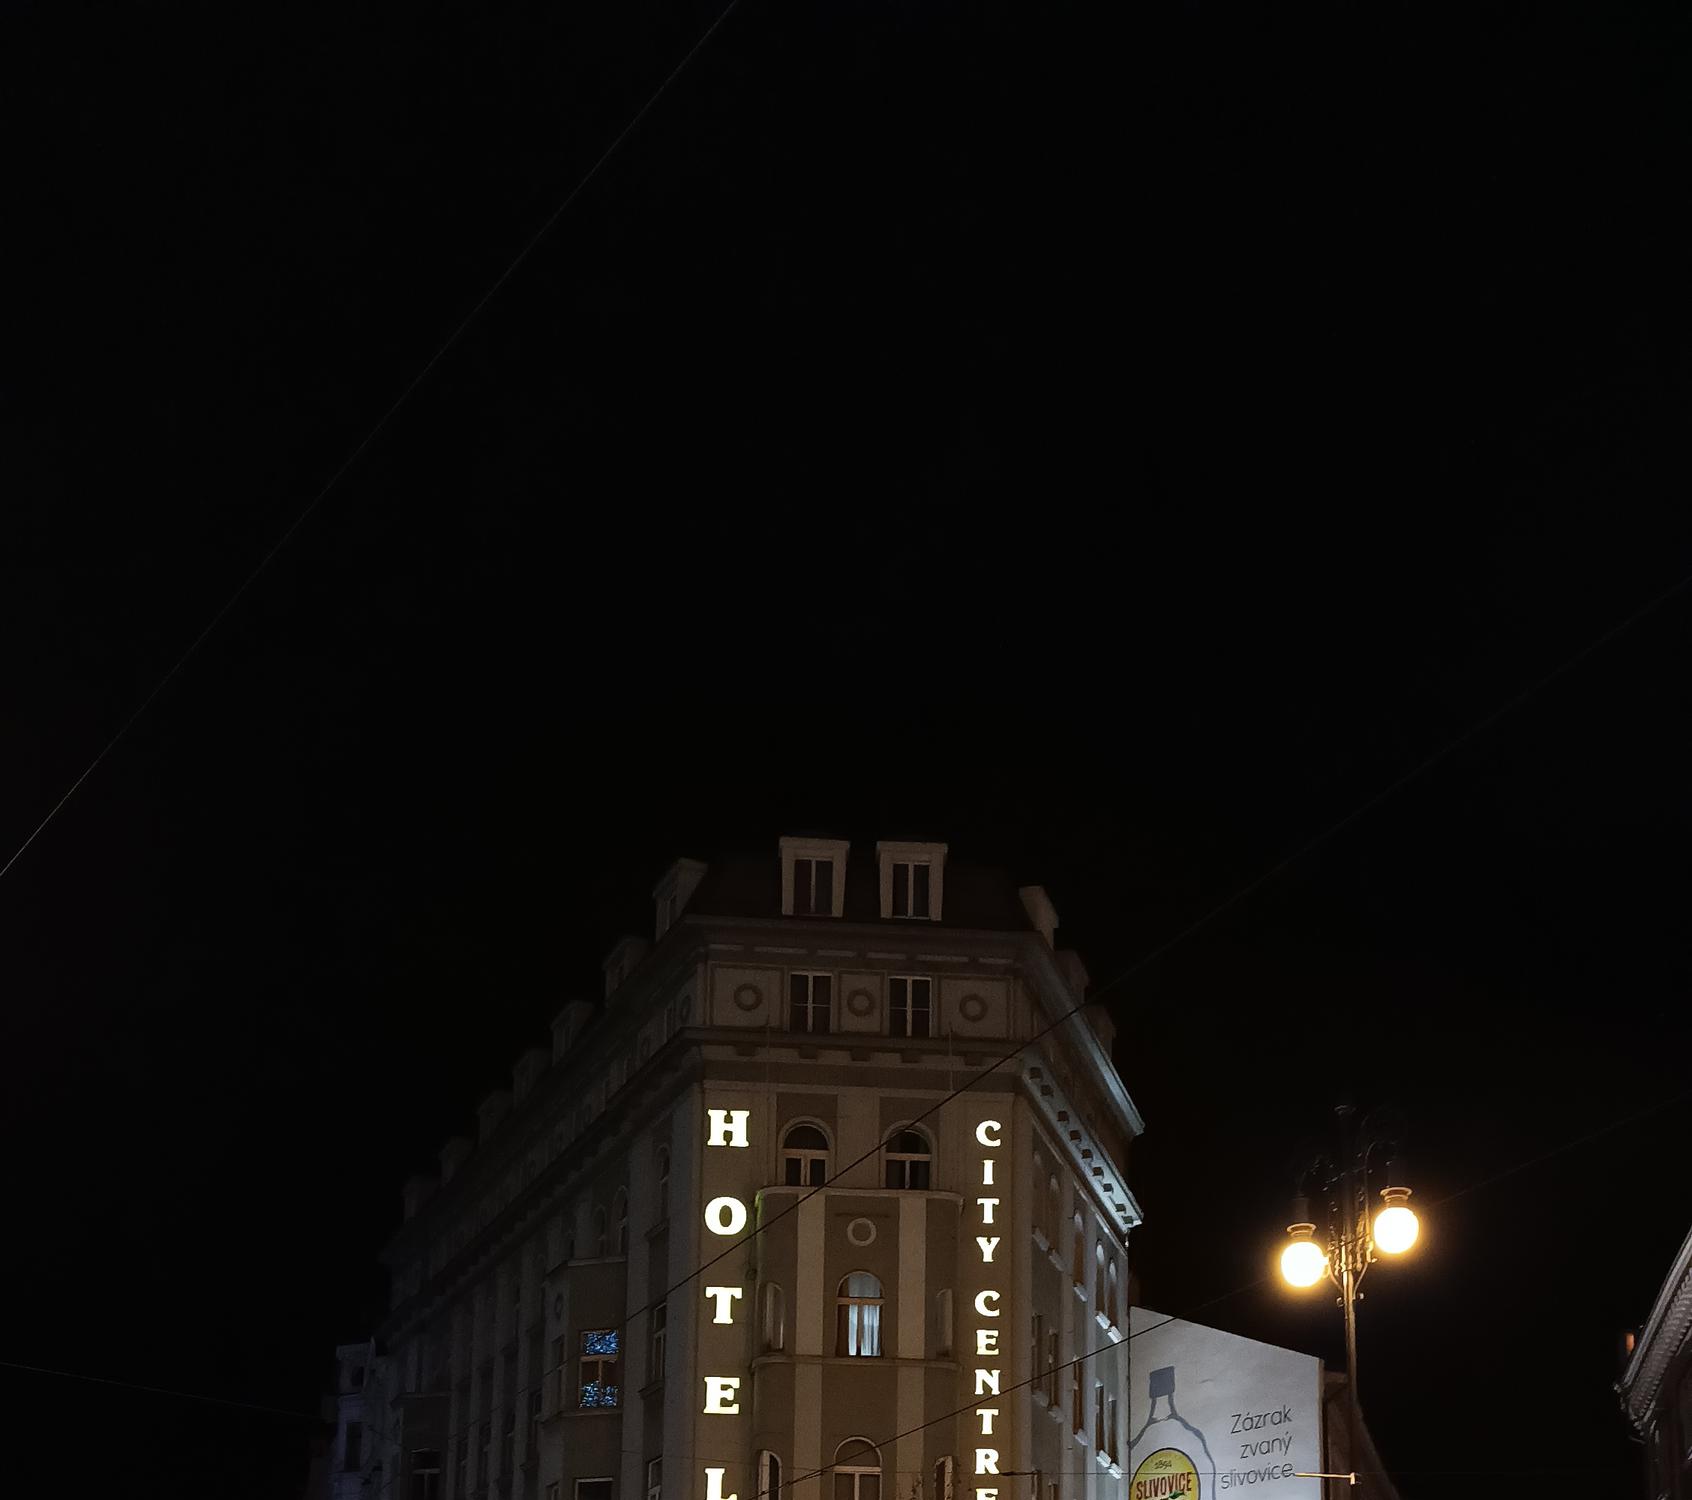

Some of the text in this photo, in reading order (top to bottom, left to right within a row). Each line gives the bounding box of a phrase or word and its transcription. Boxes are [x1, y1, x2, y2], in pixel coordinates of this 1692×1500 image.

[975, 1119, 1002, 1263] CITY
[1230, 1404, 1293, 1435] Zázrak
[1240, 1431, 1293, 1459] zvaný
[1136, 1471, 1193, 1500] SLIVOVICE
[1221, 1462, 1294, 1490] slivovice
